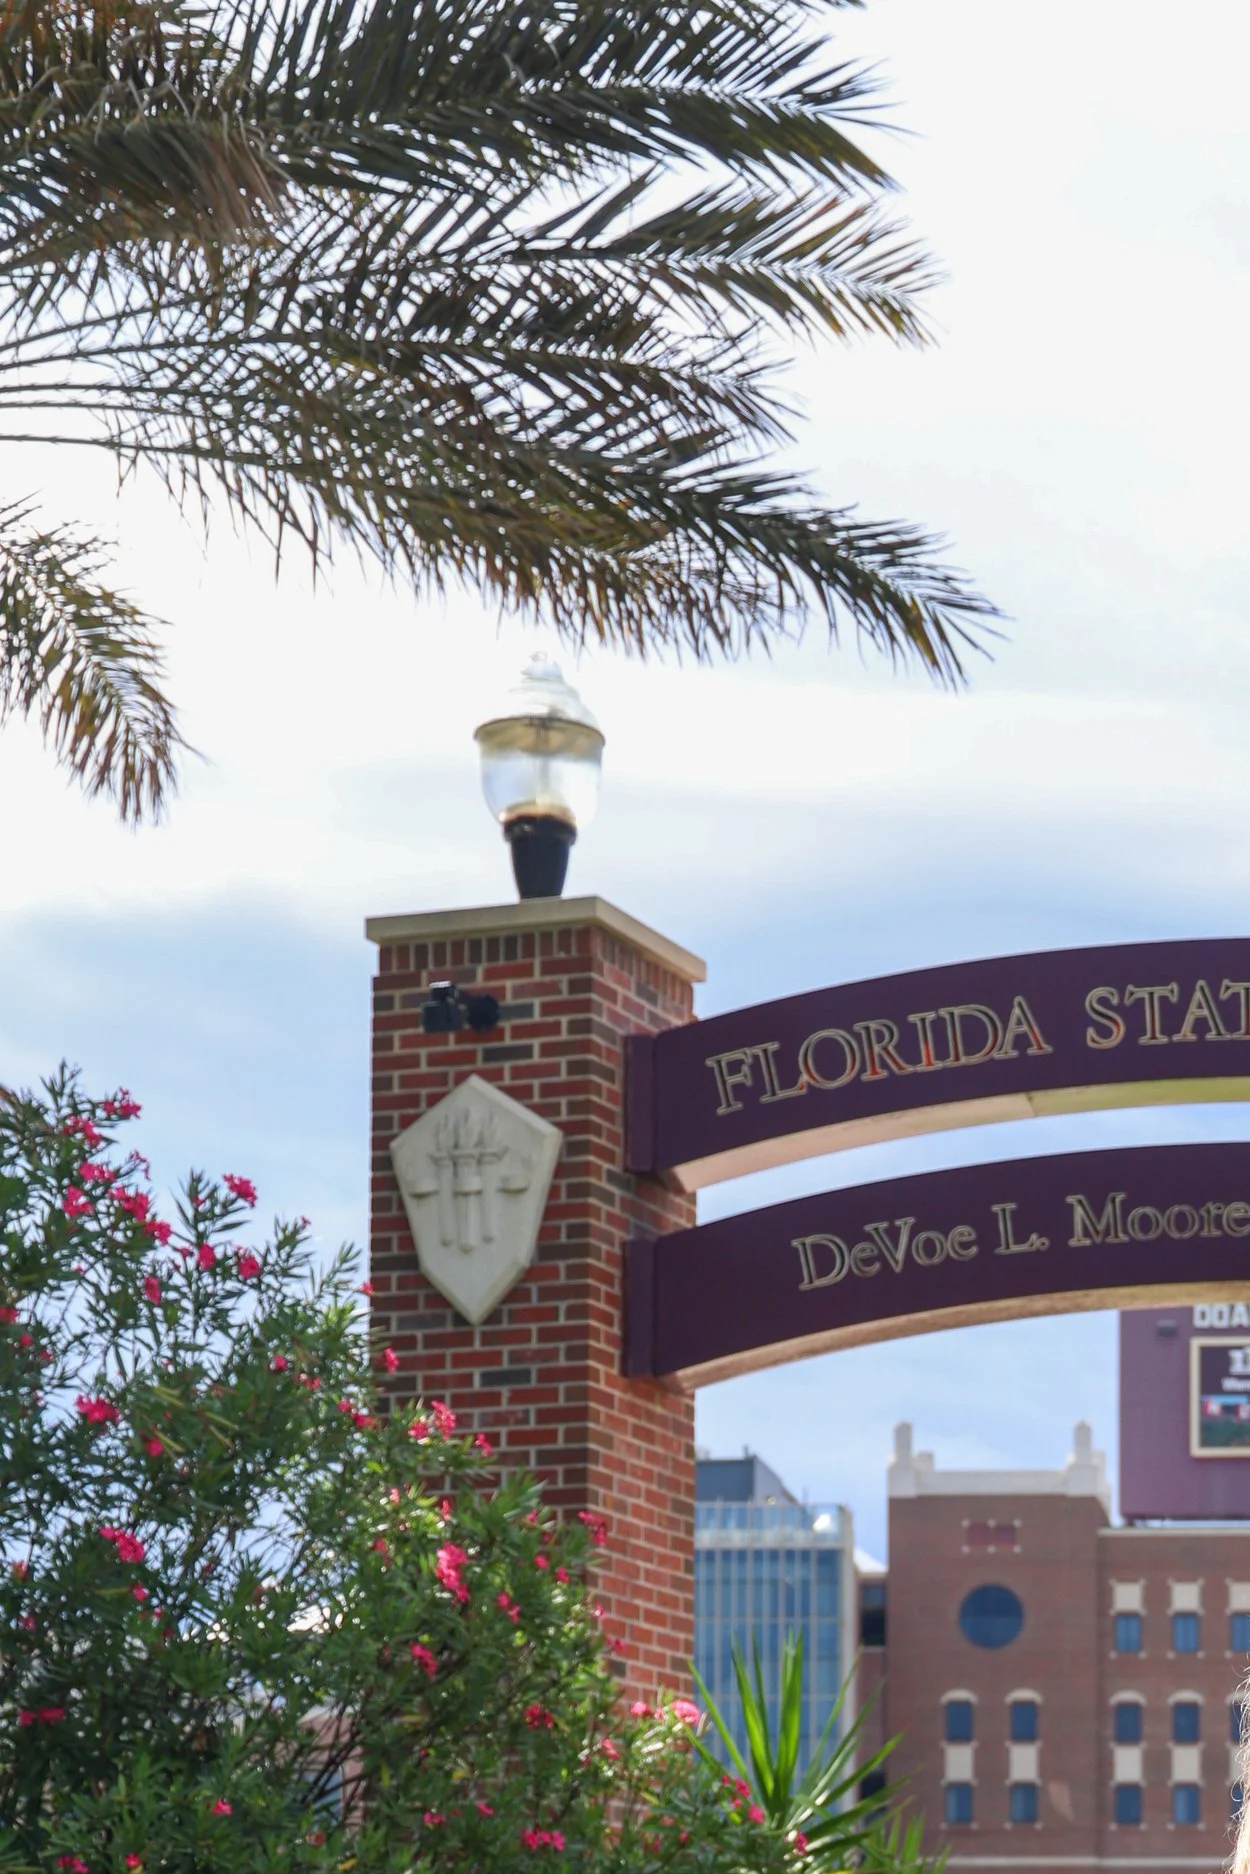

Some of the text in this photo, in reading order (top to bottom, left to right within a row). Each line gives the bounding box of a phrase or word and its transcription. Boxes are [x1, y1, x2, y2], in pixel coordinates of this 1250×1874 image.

[705, 996, 1053, 1116] FLORIDA
[791, 1216, 979, 1291] DeVoe
[992, 1203, 1050, 1255] L.
